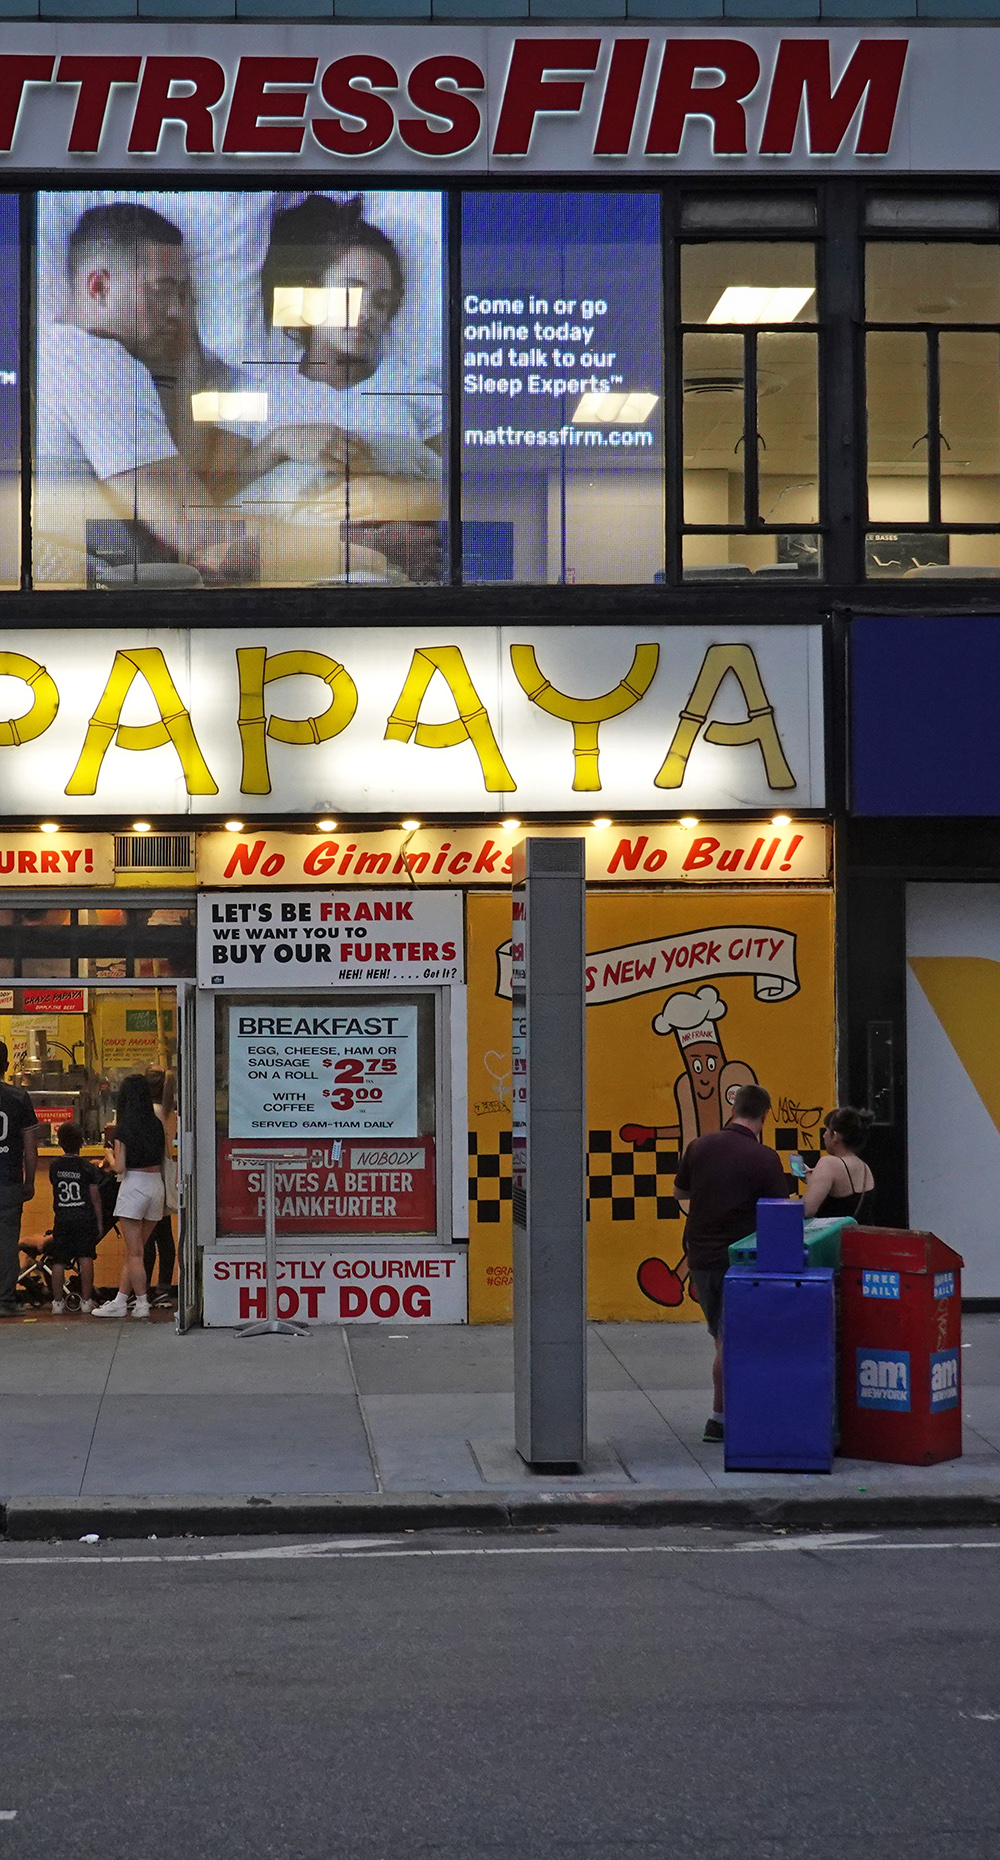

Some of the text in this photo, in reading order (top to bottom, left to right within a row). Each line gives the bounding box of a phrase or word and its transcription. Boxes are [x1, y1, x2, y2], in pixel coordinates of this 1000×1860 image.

[464, 295, 607, 319] Come in or go
[464, 321, 595, 346] online today
[464, 348, 616, 368] and talk to our
[464, 374, 522, 399] Sleep
[464, 425, 653, 447] mattressfirm.com
[875, 534, 898, 542] BASES
[224, 839, 514, 878] No Gimmicks
[607, 834, 804, 874] No Bull!
[211, 901, 414, 923] LET'S BE FRANK
[213, 927, 367, 939] WE WANT YOU TO
[212, 942, 457, 964] BUY OUR FURTERS
[603, 957, 656, 986] NEW
[661, 941, 721, 972] YORK
[728, 938, 785, 961] CITY
[339, 968, 458, 979] HEH! HEH! Got It?
[52, 990, 82, 1001] PAPAYA
[239, 1017, 399, 1036] BREAKFAST
[248, 1046, 397, 1056] EGG, CHEESE, HAM OR
[248, 1058, 310, 1067] SAUSAGE
[248, 1071, 318, 1080] ON A ROLL
[273, 1092, 306, 1101] WITH
[263, 1103, 315, 1112] COFFEE
[251, 1120, 394, 1128] SERVED 6AM-11AM DAILY
[357, 1151, 419, 1166] NOBODY
[58, 1181, 81, 1202] 30
[324, 1173, 339, 1192] A
[345, 1172, 413, 1192] BETTER
[332, 1259, 456, 1278] GOURMET
[865, 1273, 896, 1284] FREE
[863, 1285, 899, 1296] DAILY
[239, 1285, 431, 1319] HOT DOG
